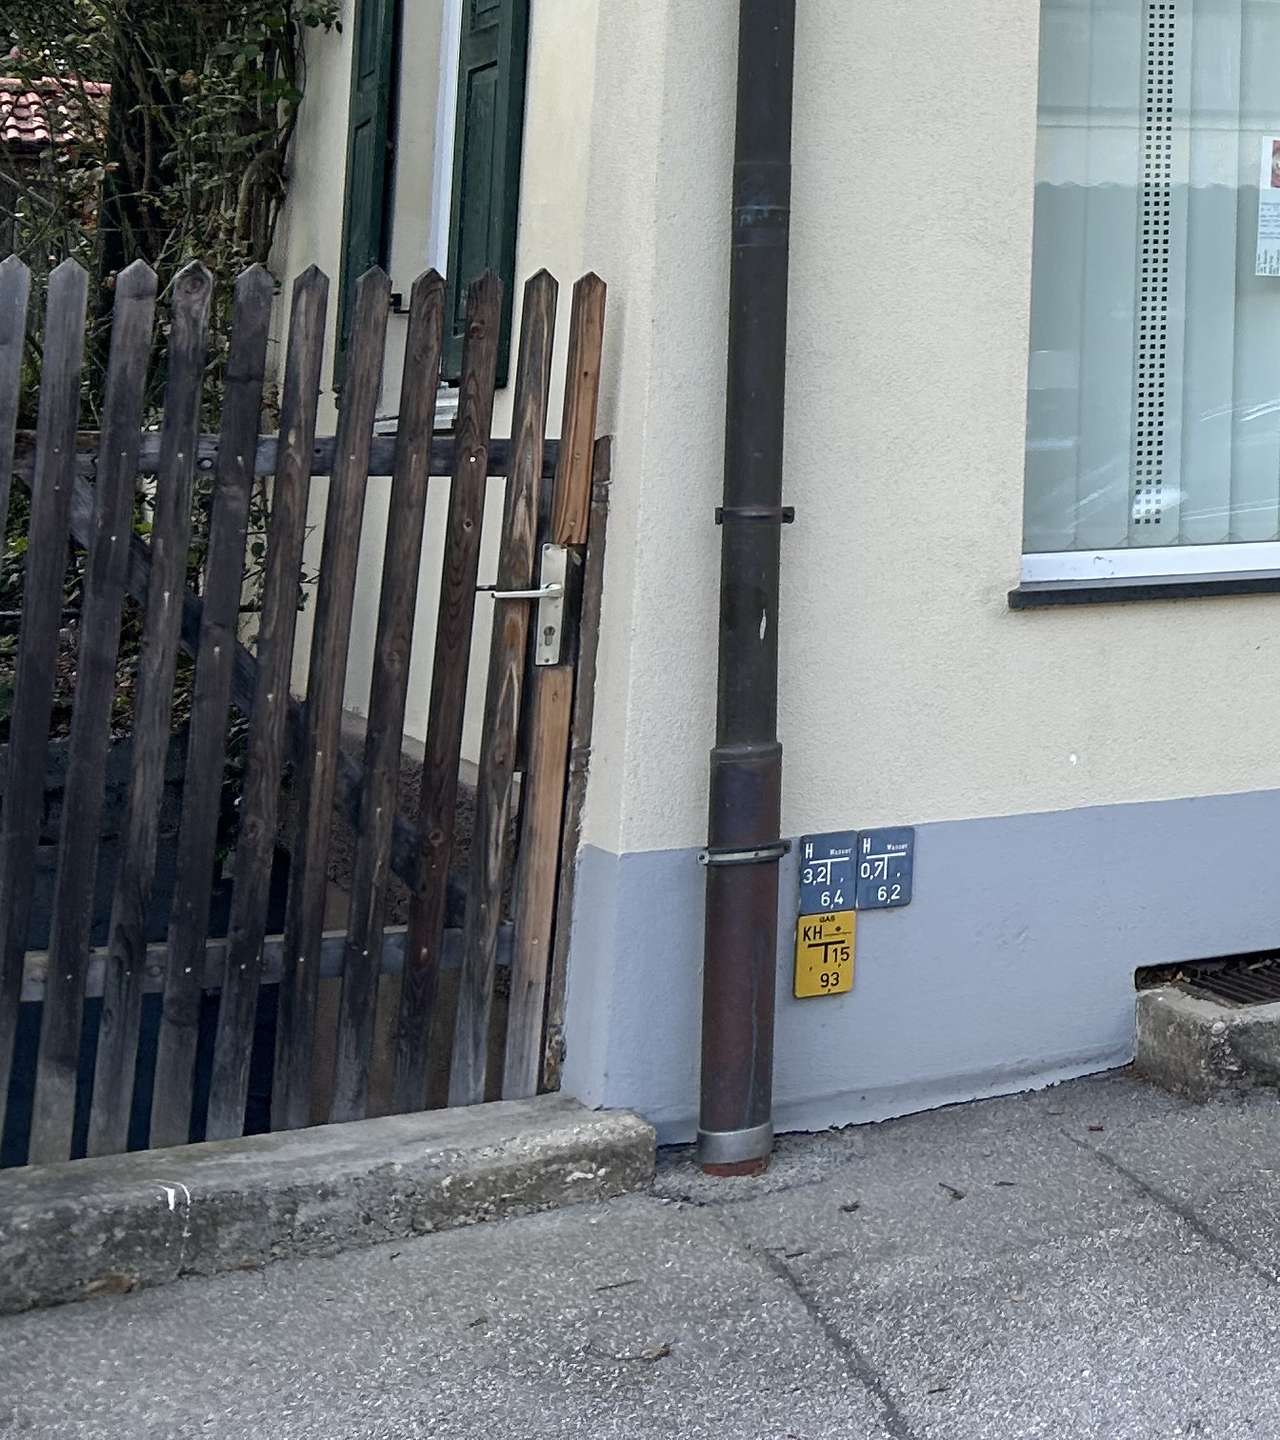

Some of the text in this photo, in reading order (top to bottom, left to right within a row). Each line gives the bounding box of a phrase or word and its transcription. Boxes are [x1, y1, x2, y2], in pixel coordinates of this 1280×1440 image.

[805, 843, 813, 860] H
[863, 838, 871, 853] H
[803, 867, 827, 885] 3,2
[861, 862, 883, 880] 0,7
[821, 890, 844, 909] 6,4
[878, 884, 901, 904] 6,2
[803, 925, 822, 942] KH
[832, 946, 850, 964] 15
[820, 972, 839, 988] 93
